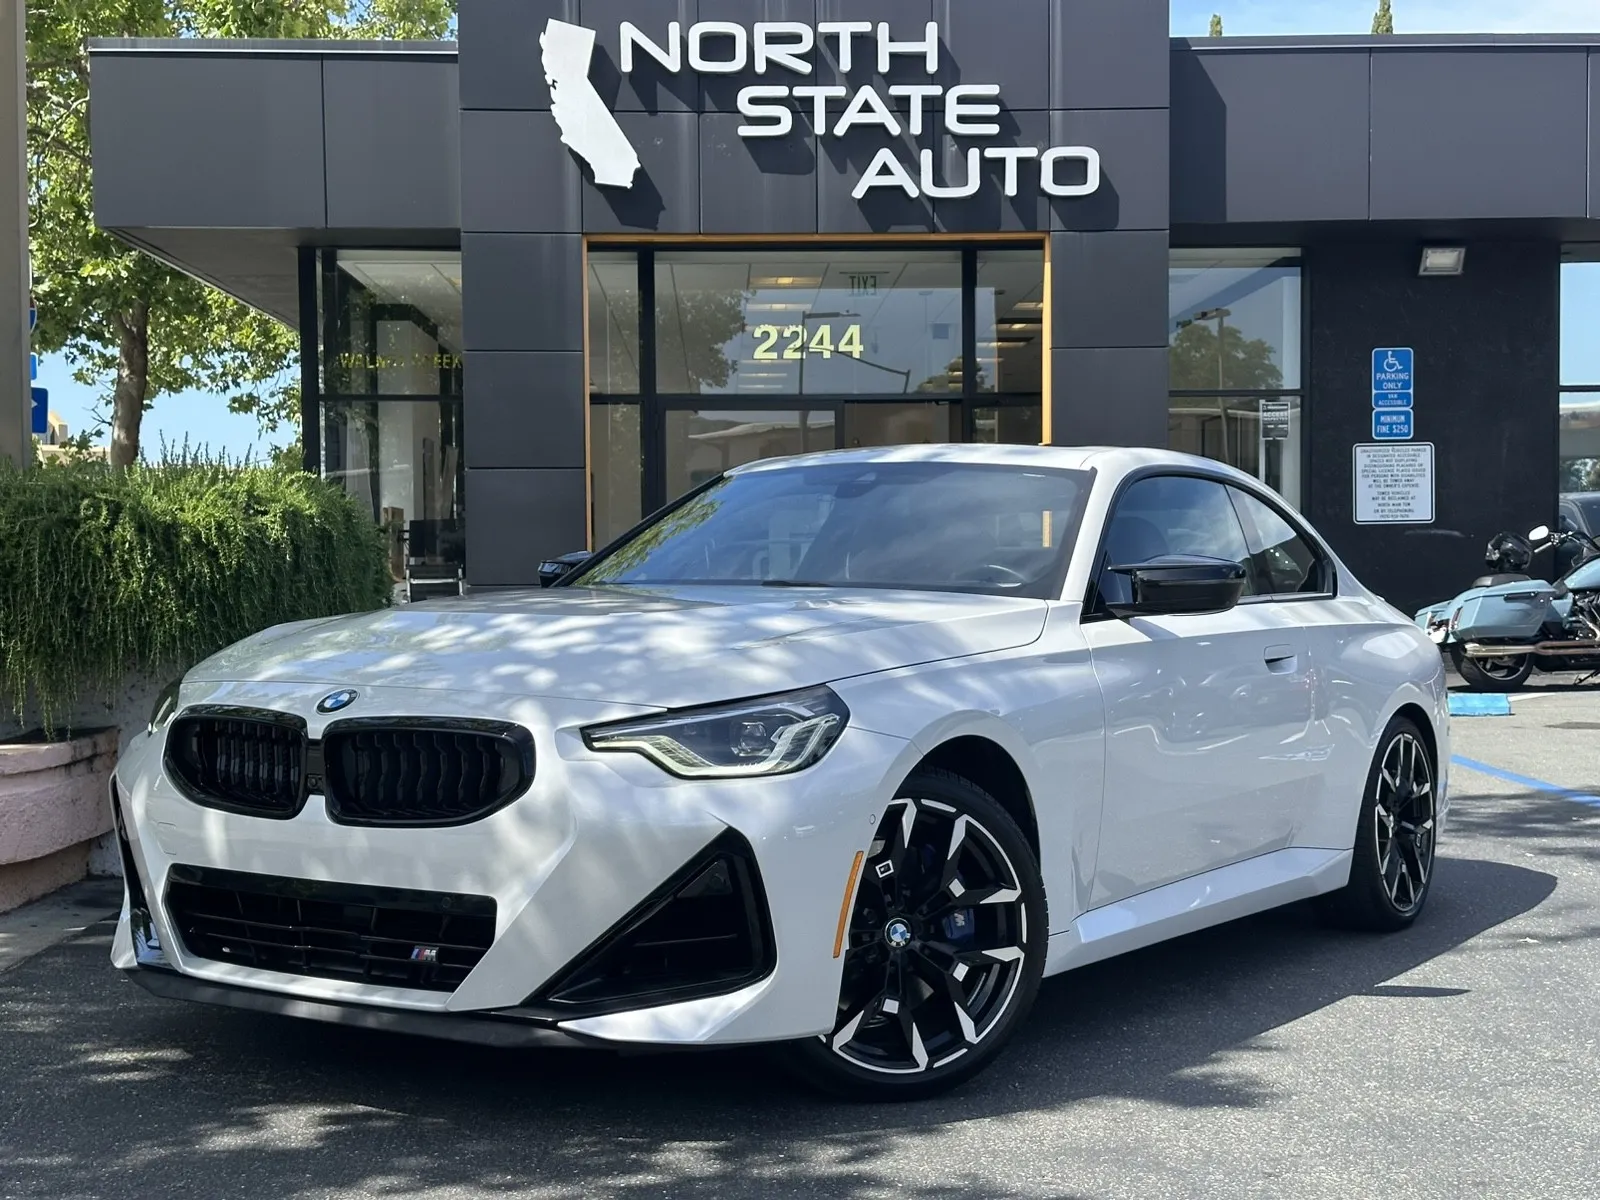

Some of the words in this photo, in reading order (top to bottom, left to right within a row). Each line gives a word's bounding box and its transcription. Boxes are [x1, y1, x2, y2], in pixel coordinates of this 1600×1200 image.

[620, 21, 938, 74] NORTH
[737, 84, 1000, 137] STATE
[851, 146, 1100, 199] AUTO
[753, 324, 864, 360] 2244
[1376, 425, 1390, 433] FINE
[1392, 424, 1409, 433] $250
[1380, 415, 1405, 423] MINIMUM
